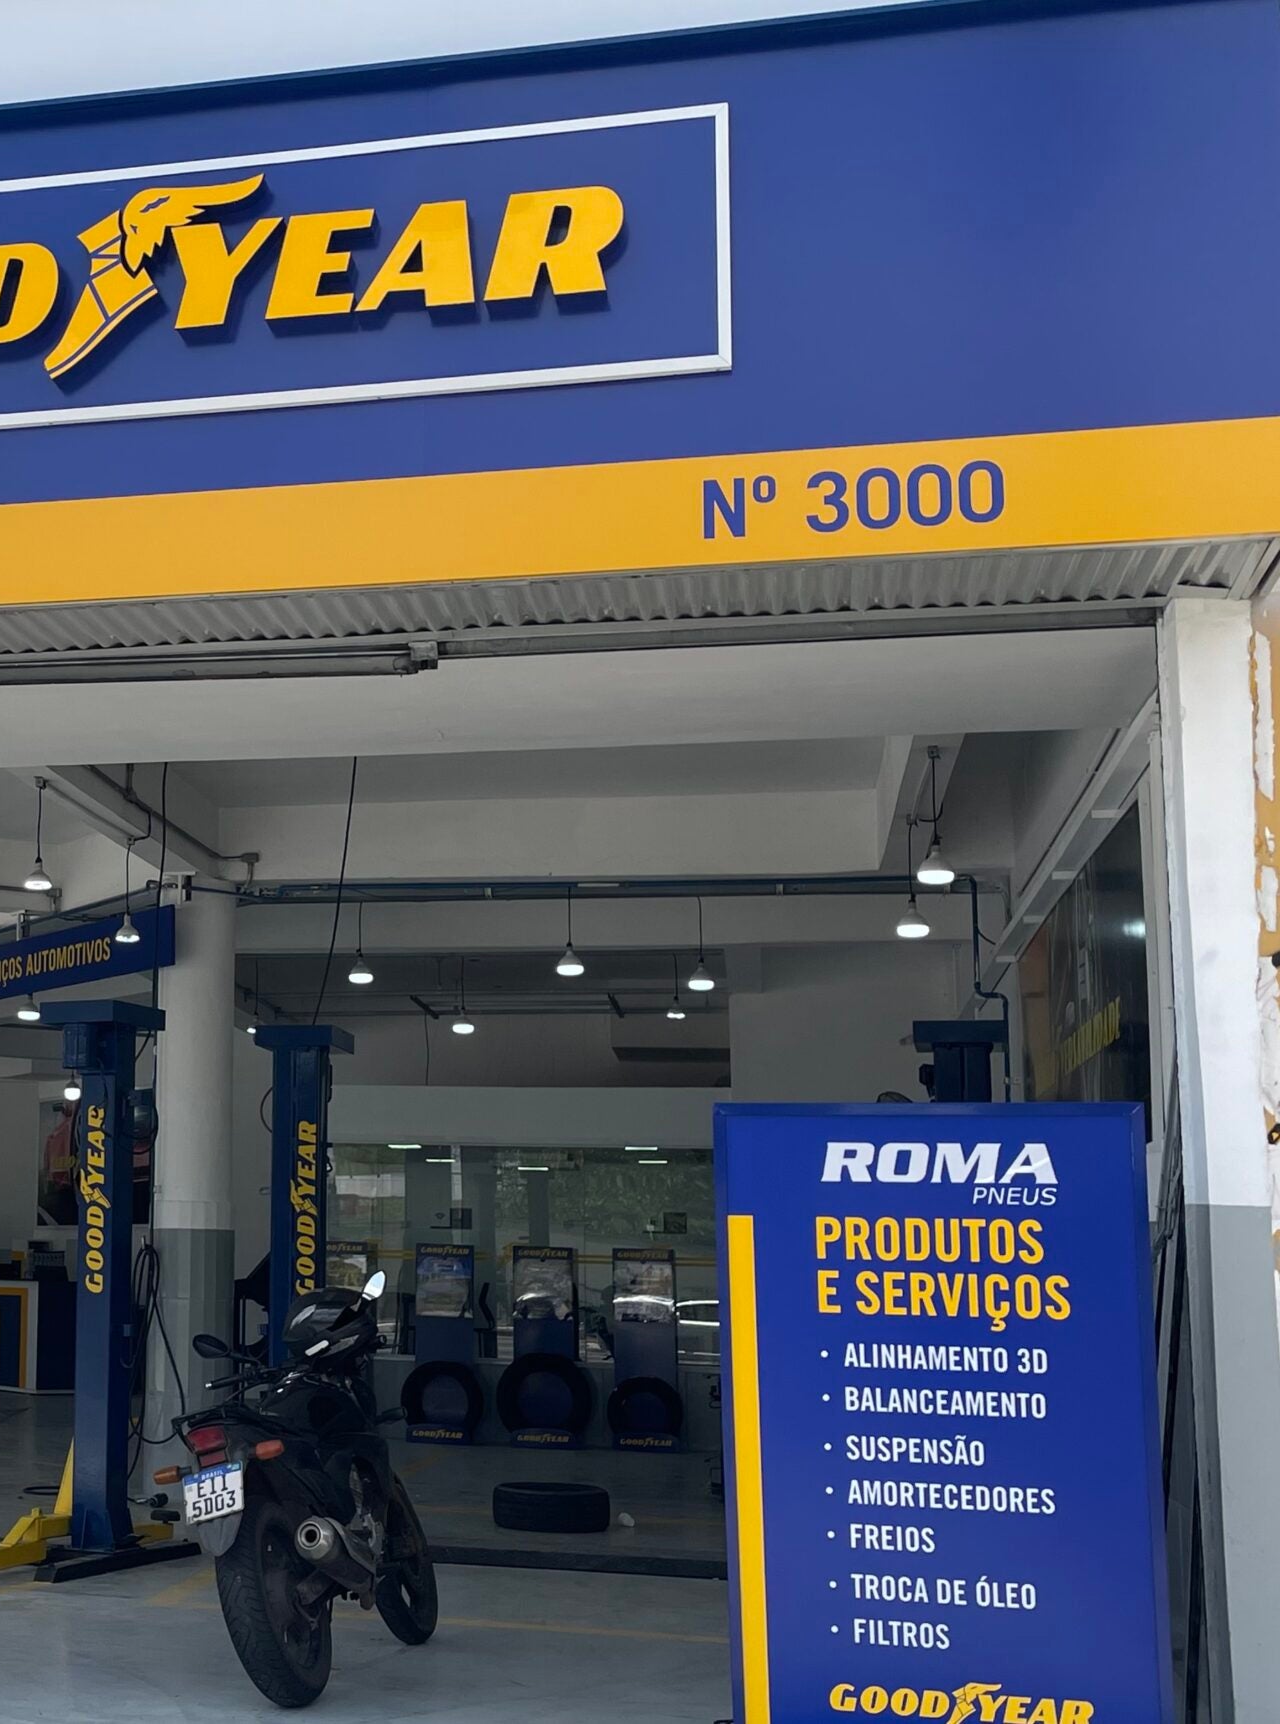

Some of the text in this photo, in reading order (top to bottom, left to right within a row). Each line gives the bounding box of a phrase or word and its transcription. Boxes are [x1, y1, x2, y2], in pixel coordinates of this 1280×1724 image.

[806, 460, 1005, 533] 3000
[25, 938, 111, 977] AUTOMOTIVOS
[821, 1141, 1059, 1184] ROMA
[972, 1187, 1058, 1206] PNEUS
[815, 1216, 1045, 1265] PRODUTOS
[817, 1270, 1071, 1332] E SERVIÇOS
[844, 1343, 1048, 1375] ALINHAMENTO 3D
[844, 1386, 1047, 1419] BALANCEAMENTO
[845, 1434, 985, 1467] SUSPENSÃO
[201, 1469, 225, 1481] BRASIL
[192, 1490, 236, 1519] 5D03
[848, 1479, 1056, 1514] AMORTECEDORES
[850, 1523, 935, 1553] FREIOS
[851, 1573, 1037, 1610] TROCA DE ÓLEO
[854, 1618, 950, 1650] FILTROS
